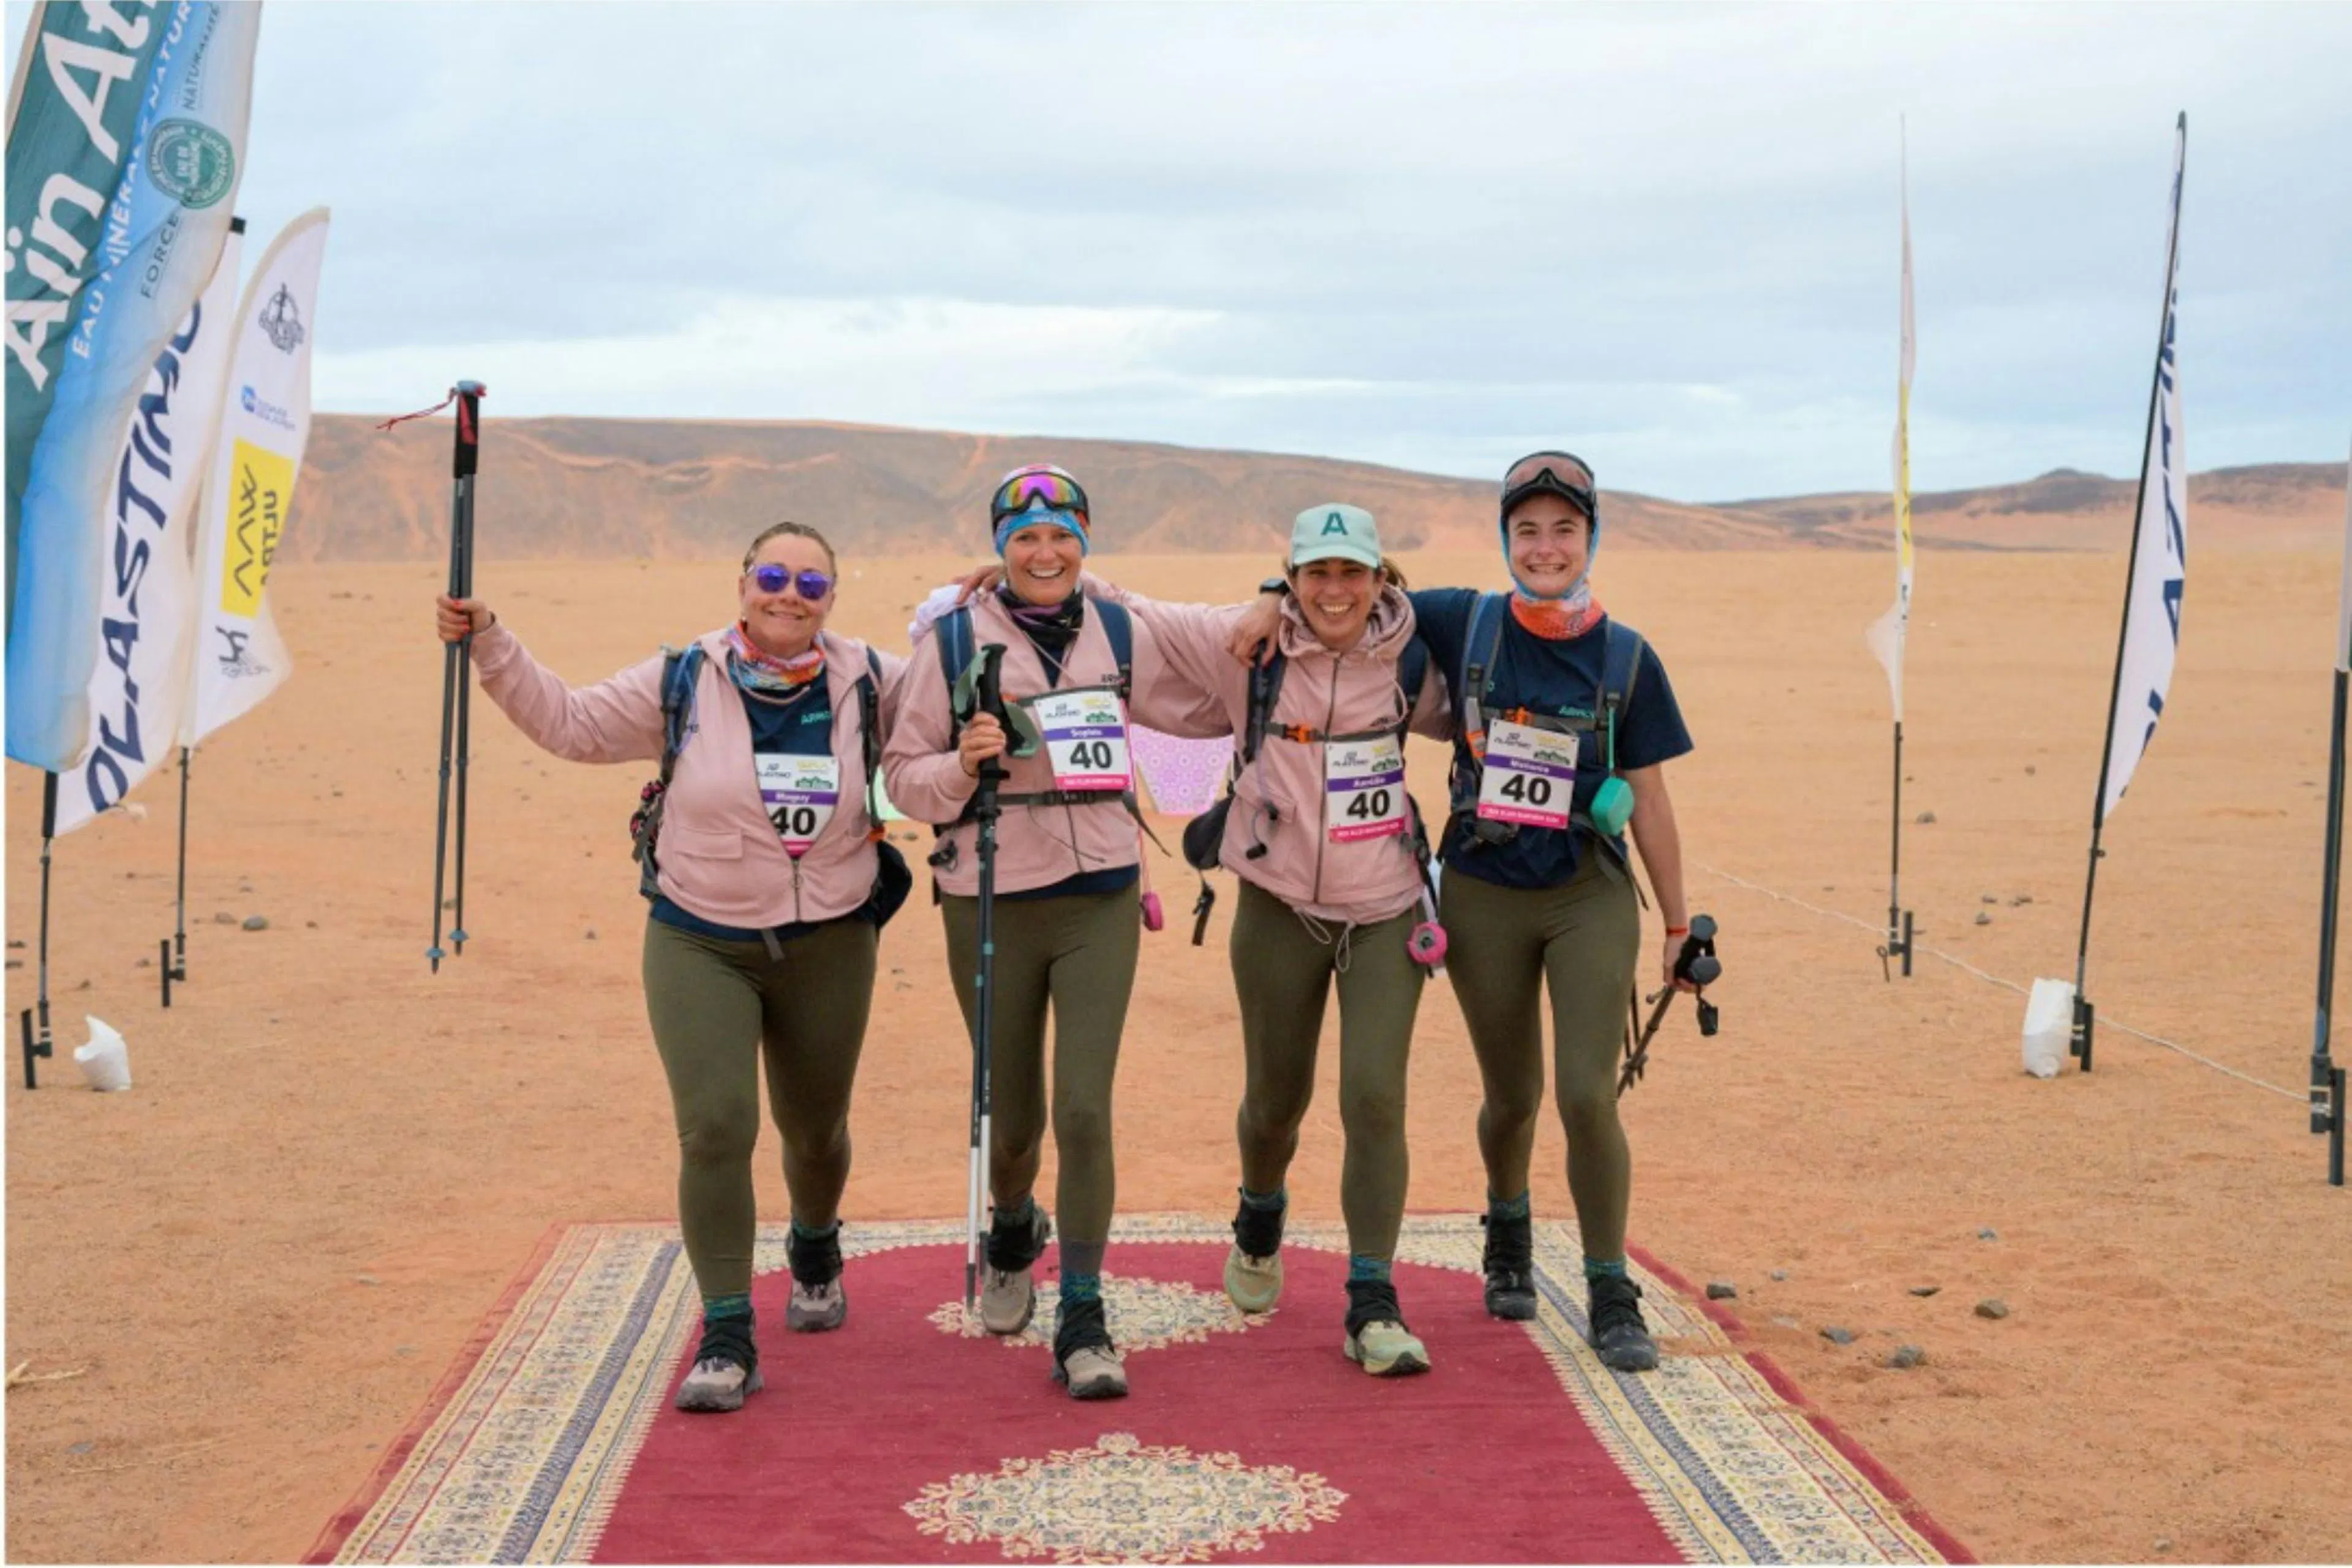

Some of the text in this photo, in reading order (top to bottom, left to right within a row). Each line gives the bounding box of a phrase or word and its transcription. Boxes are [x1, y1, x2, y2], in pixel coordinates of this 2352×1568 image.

[5, 0, 157, 392] Aïn At
[141, 214, 179, 300] FORCE
[72, 289, 105, 360] EAU
[1320, 511, 1349, 536] A
[1069, 741, 1112, 769] 40
[1346, 788, 1390, 819] 40
[1500, 773, 1551, 805] 40
[769, 805, 816, 836] 40
